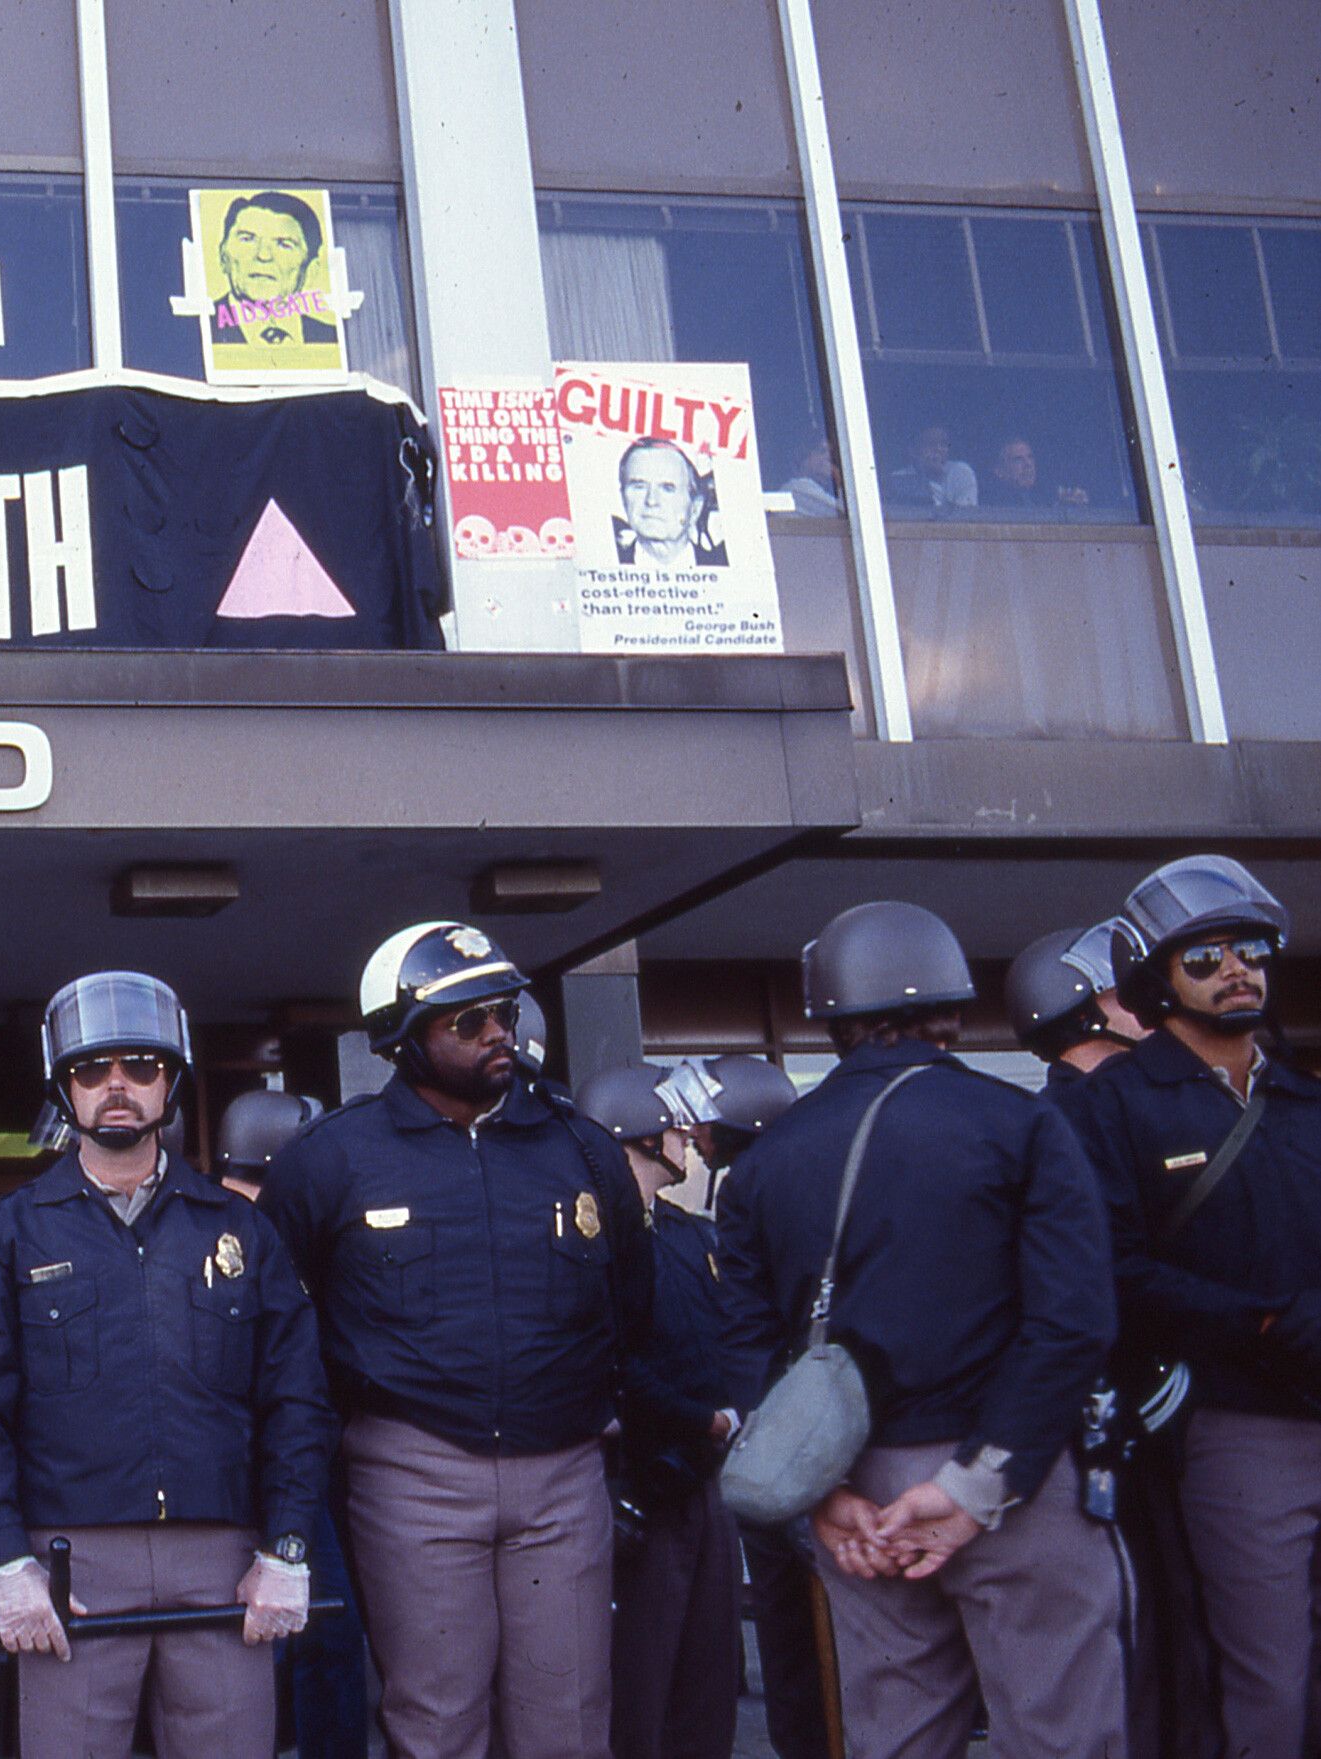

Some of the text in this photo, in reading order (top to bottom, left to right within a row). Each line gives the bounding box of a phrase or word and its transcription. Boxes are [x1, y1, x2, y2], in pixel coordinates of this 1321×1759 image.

[217, 290, 329, 329] AIDSGATE
[441, 391, 555, 409] TIME ISN'T
[443, 408, 556, 427] THE ONLY
[557, 379, 742, 450] GUILTY
[446, 427, 560, 446] THING THE
[536, 445, 562, 463] IS
[451, 463, 563, 482] KILLING
[656, 571, 670, 582] is
[675, 572, 718, 583] more
[581, 587, 699, 599] cost-effective
[583, 603, 622, 615] than
[684, 620, 775, 633] George Bush
[614, 634, 777, 645] Presidential Candidate
